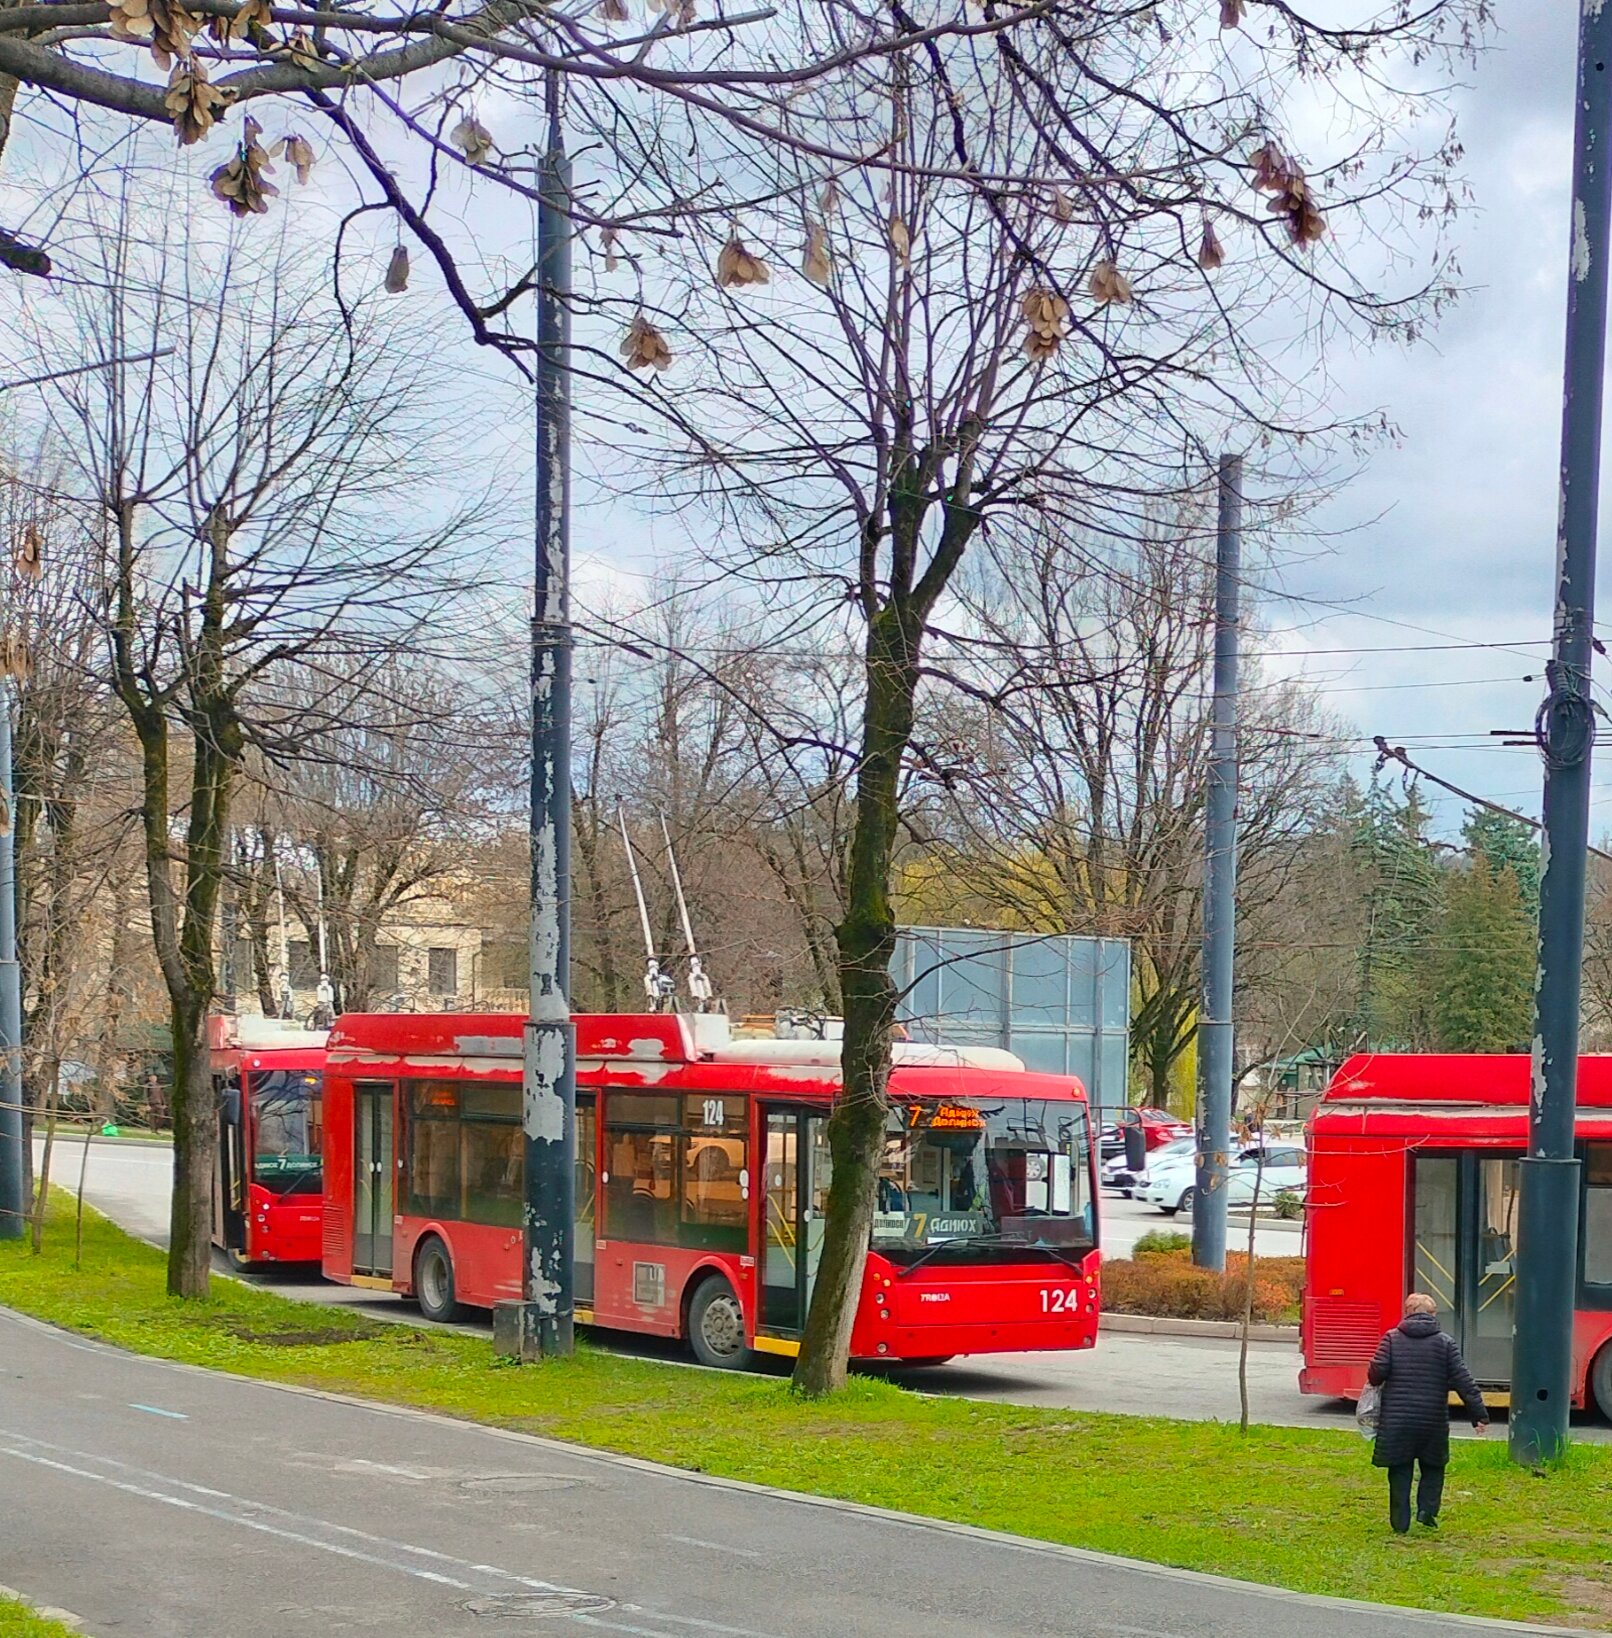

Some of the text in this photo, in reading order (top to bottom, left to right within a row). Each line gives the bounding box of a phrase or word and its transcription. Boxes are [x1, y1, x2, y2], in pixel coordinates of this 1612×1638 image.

[702, 1099, 725, 1126] 124
[909, 1106, 921, 1127] 7
[278, 1158, 287, 1170] 7
[913, 1213, 927, 1238] 7
[1040, 1288, 1078, 1313] 124
